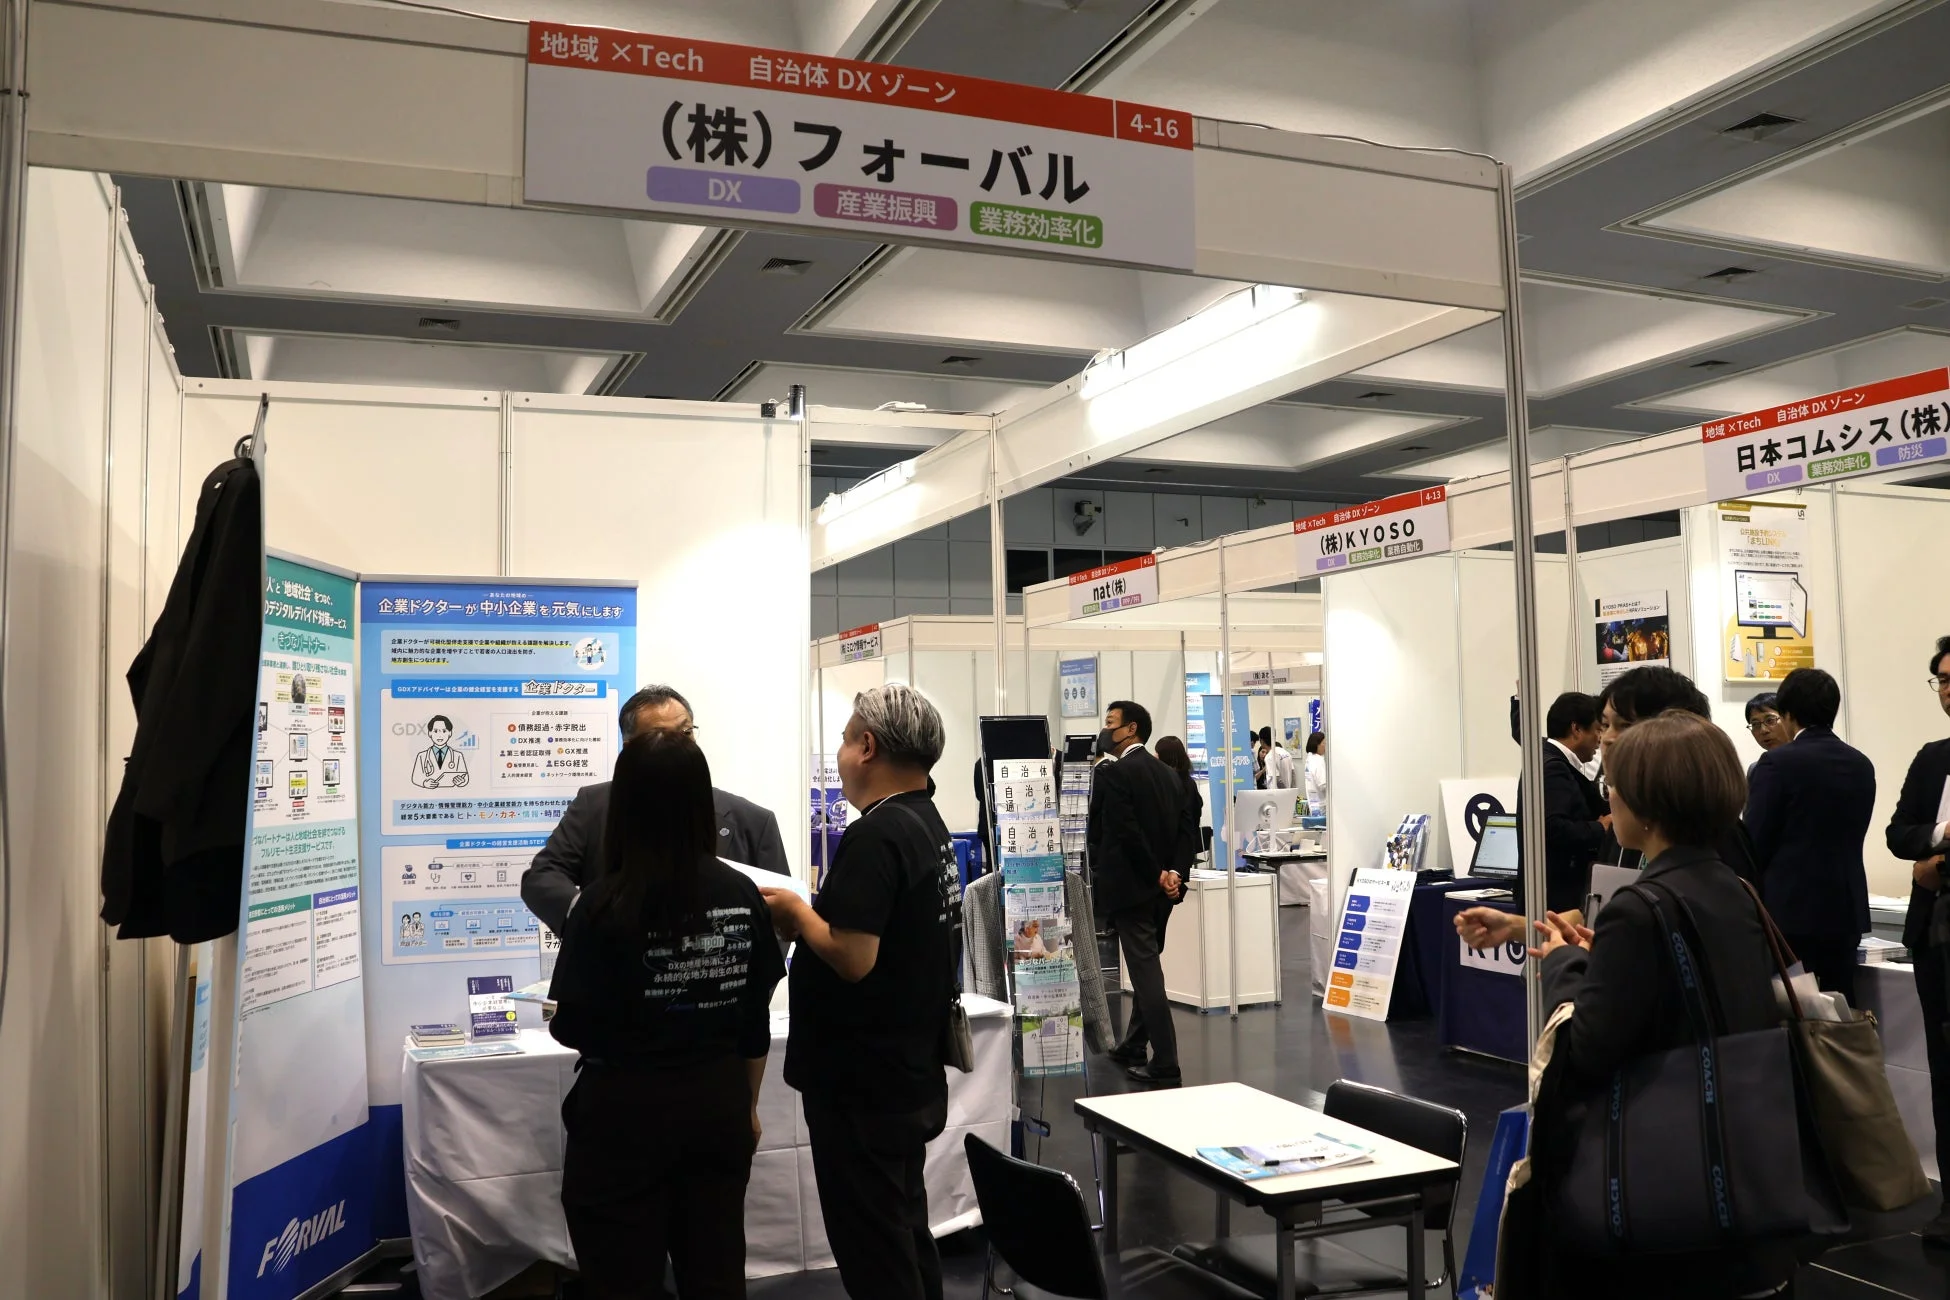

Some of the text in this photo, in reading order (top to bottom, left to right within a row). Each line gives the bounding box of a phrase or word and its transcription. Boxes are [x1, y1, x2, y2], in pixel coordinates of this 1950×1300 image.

[539, 31, 600, 63] 地域
[748, 55, 830, 91] 自治体
[837, 67, 873, 95] DX
[881, 73, 957, 104] ゾーン
[1128, 112, 1181, 141] 4-16
[707, 177, 743, 204] DX
[834, 189, 938, 227] 産業振興
[978, 206, 1097, 247] 業務効率化
[1705, 424, 1726, 439] 地域
[1776, 406, 1810, 423] 自治体
[1812, 400, 1828, 414] DX
[1830, 391, 1866, 410] ゾーン
[1898, 443, 1924, 461] 防災
[1810, 455, 1868, 477] 業務効率化
[1766, 471, 1781, 485] DX
[1425, 491, 1441, 501] 4-13
[1333, 511, 1352, 523] 自治体
[1352, 509, 1361, 518] DX
[1362, 504, 1380, 517] ゾーン
[524, 679, 596, 695] 企業ドクター
[392, 722, 426, 736] GDX
[518, 723, 587, 732] 債務超過・赤字脱出
[506, 749, 551, 757] 第三者認証取得
[553, 759, 589, 768] ESG経営
[1701, 1046, 1714, 1104] COACH
[1609, 1177, 1623, 1238] COACH
